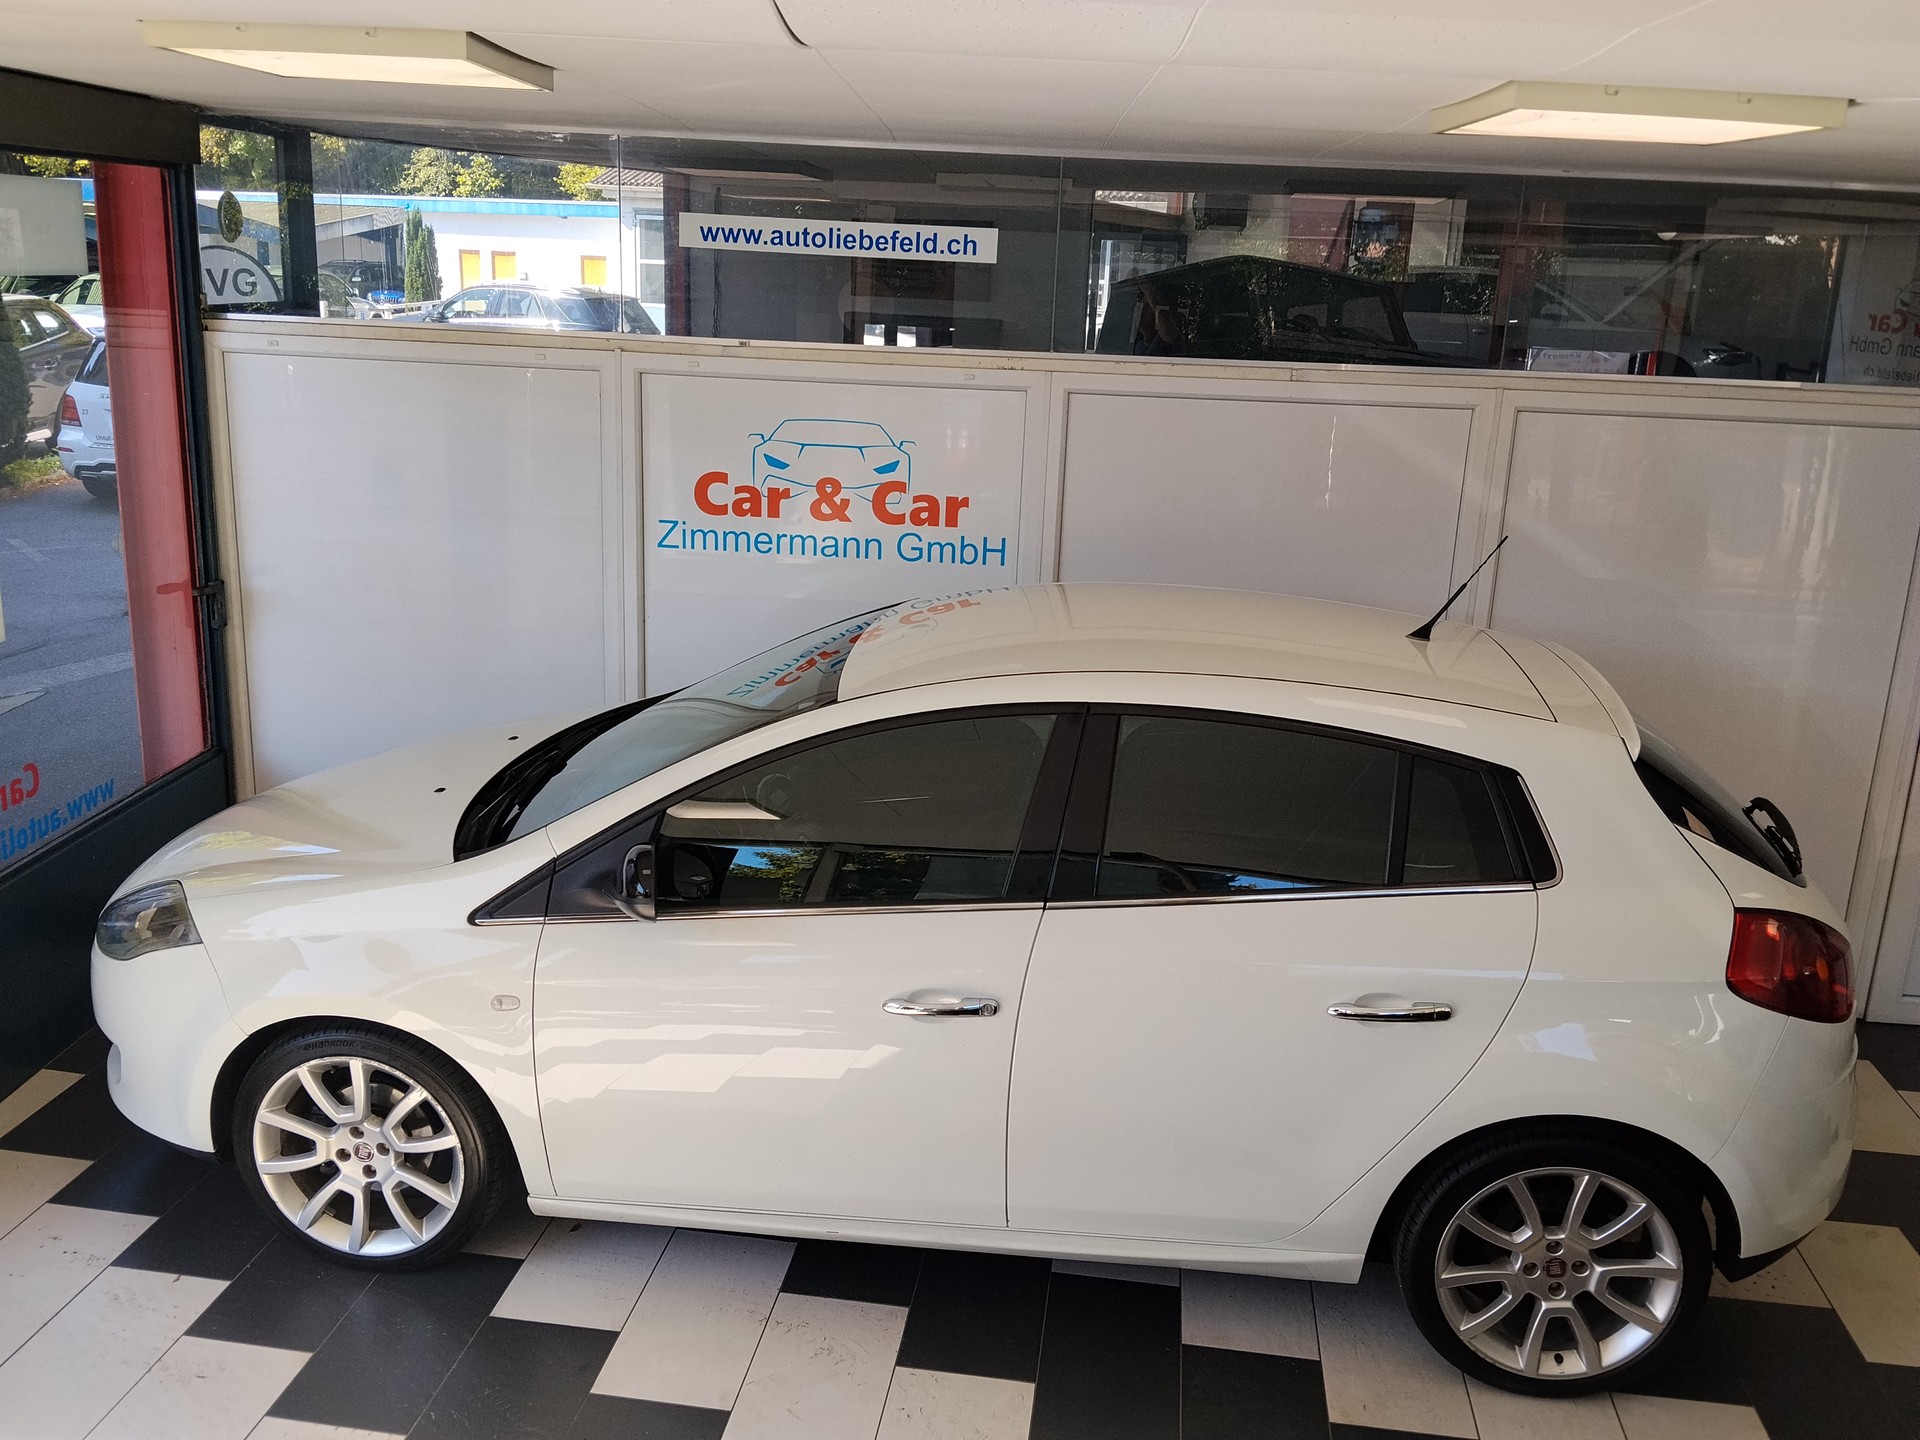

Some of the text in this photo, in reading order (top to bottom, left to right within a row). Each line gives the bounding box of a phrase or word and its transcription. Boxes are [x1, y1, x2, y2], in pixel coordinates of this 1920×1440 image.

[699, 225, 978, 256] www.autoliebefeld.ch
[693, 471, 970, 528] Car & Car
[656, 519, 1007, 567] Zimmermann GmbH
